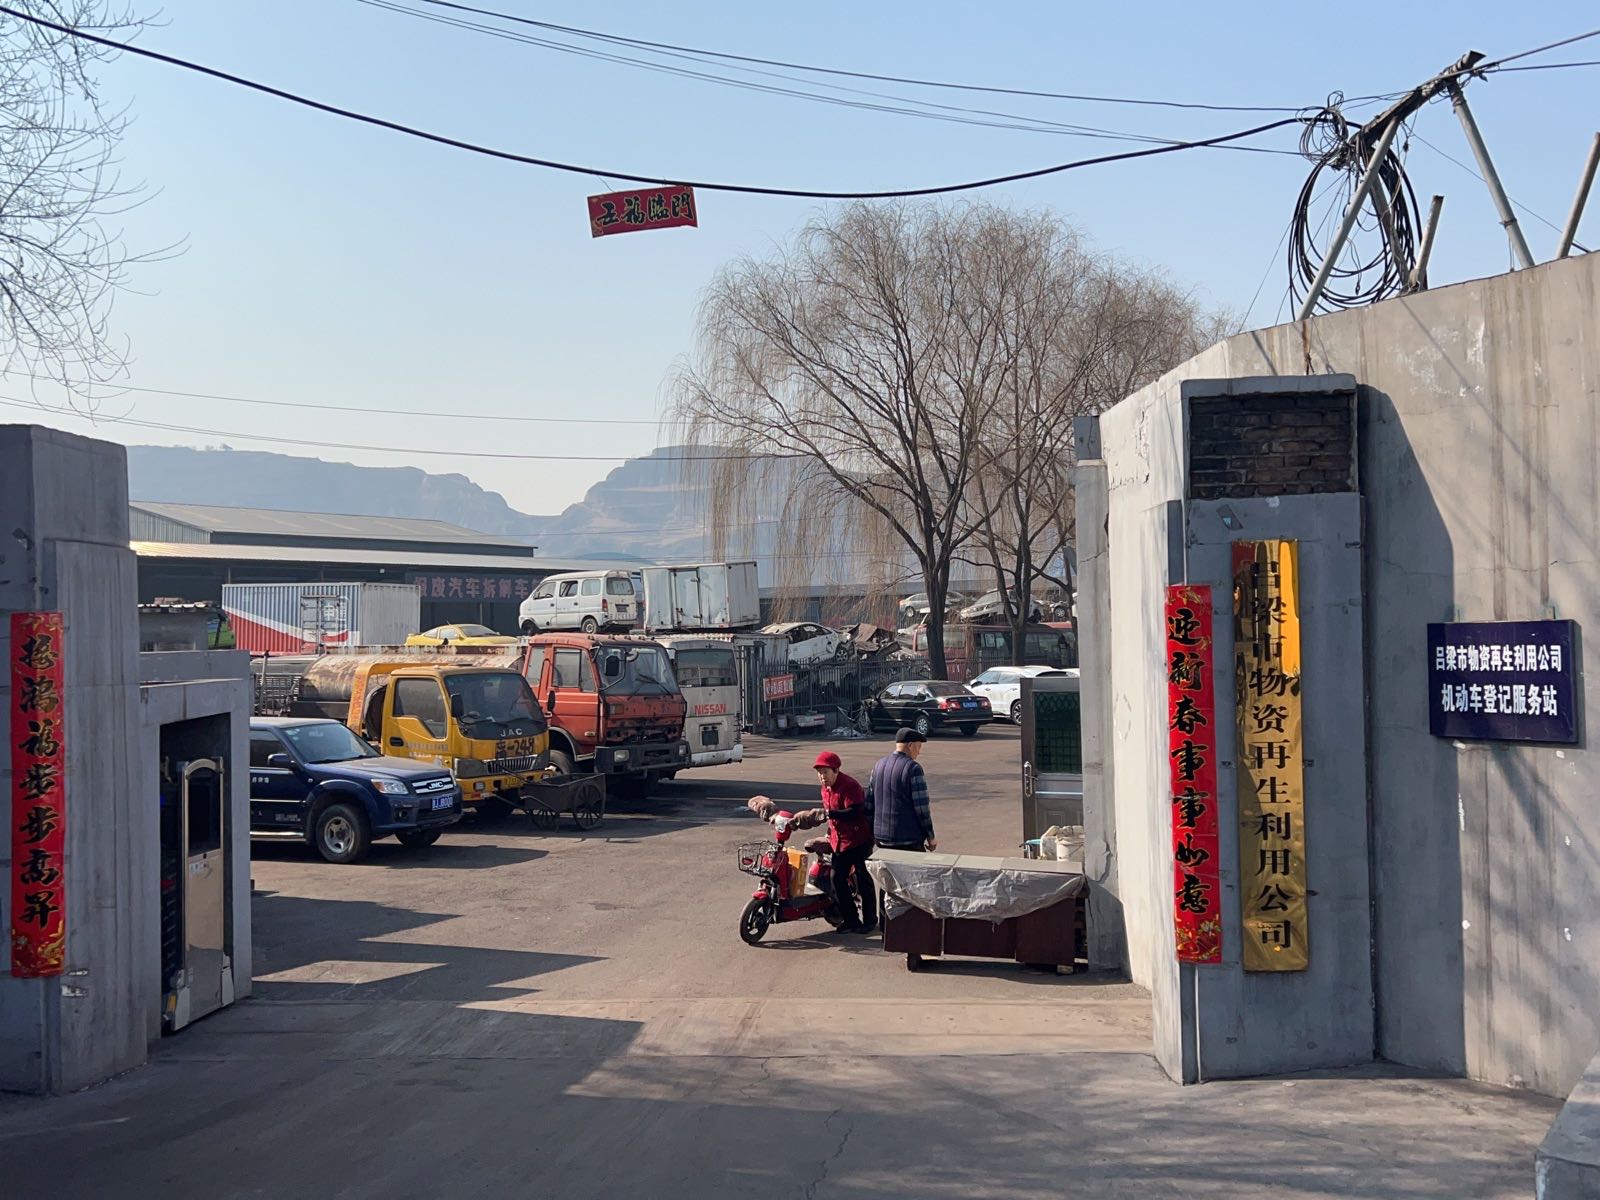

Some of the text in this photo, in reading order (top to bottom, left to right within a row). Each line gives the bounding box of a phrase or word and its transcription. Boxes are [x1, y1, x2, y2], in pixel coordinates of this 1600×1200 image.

[1436, 644, 1562, 672] 吕梁市物资再生利用公司
[694, 704, 726, 716] NISSAN
[1441, 683, 1558, 716] 机动车登记服务站
[500, 728, 523, 737] JAC
[1167, 607, 1211, 914] 迎新春事事如意
[1247, 560, 1293, 950] 吕梁市物资再生利用公司
[428, 781, 444, 789] JMC
